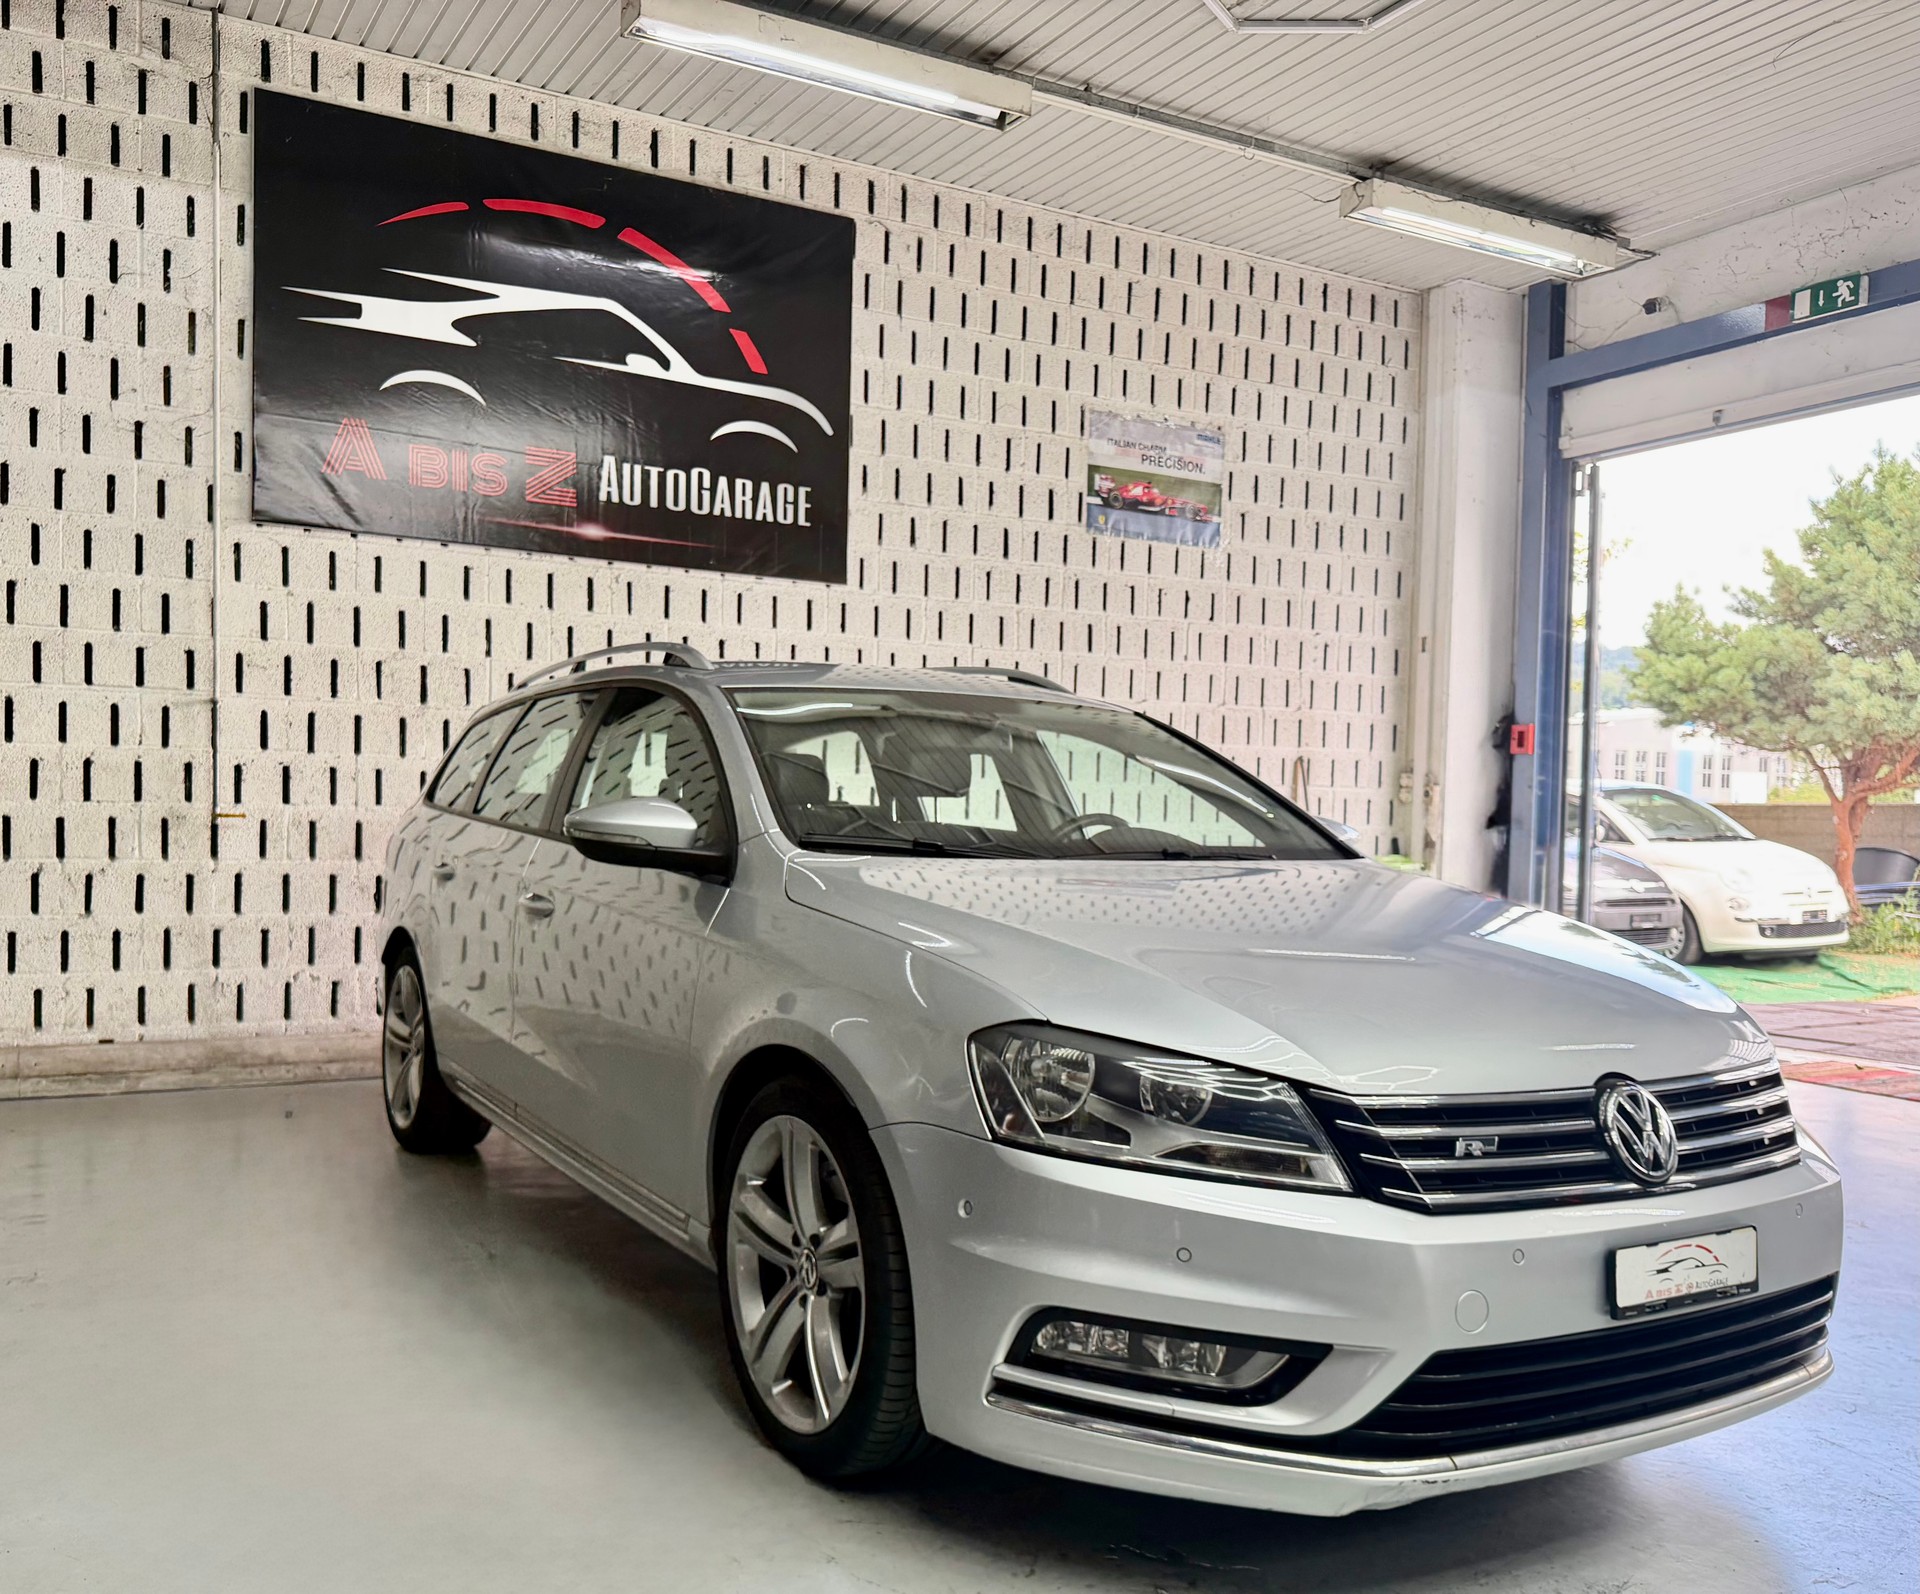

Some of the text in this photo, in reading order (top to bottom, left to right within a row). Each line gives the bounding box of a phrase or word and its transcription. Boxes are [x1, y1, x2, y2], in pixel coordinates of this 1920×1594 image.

[321, 417, 387, 480] A
[408, 444, 508, 496] BIS
[525, 446, 577, 507] Z
[1141, 454, 1206, 474] PRECISION.
